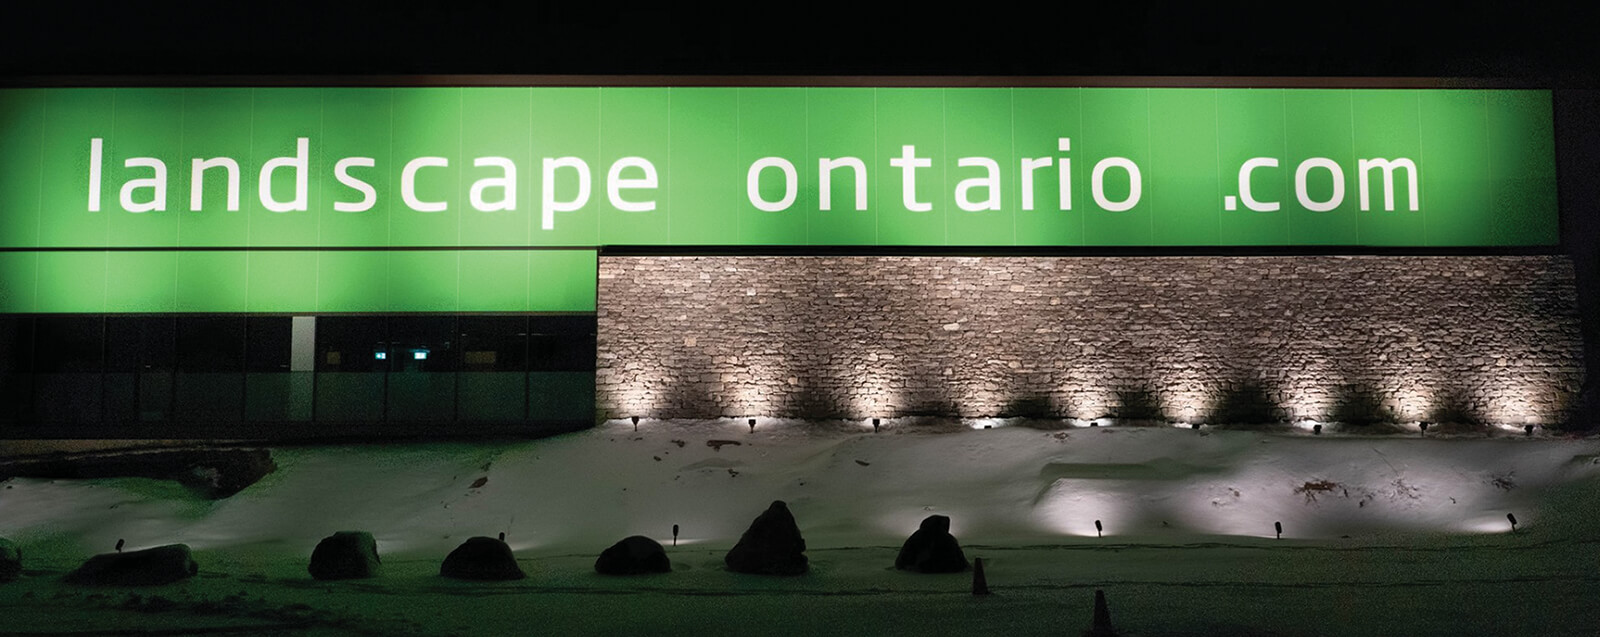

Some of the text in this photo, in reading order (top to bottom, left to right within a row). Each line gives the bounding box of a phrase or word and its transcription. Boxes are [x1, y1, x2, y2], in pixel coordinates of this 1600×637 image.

[87, 137, 1420, 231] landscape ontario .com
